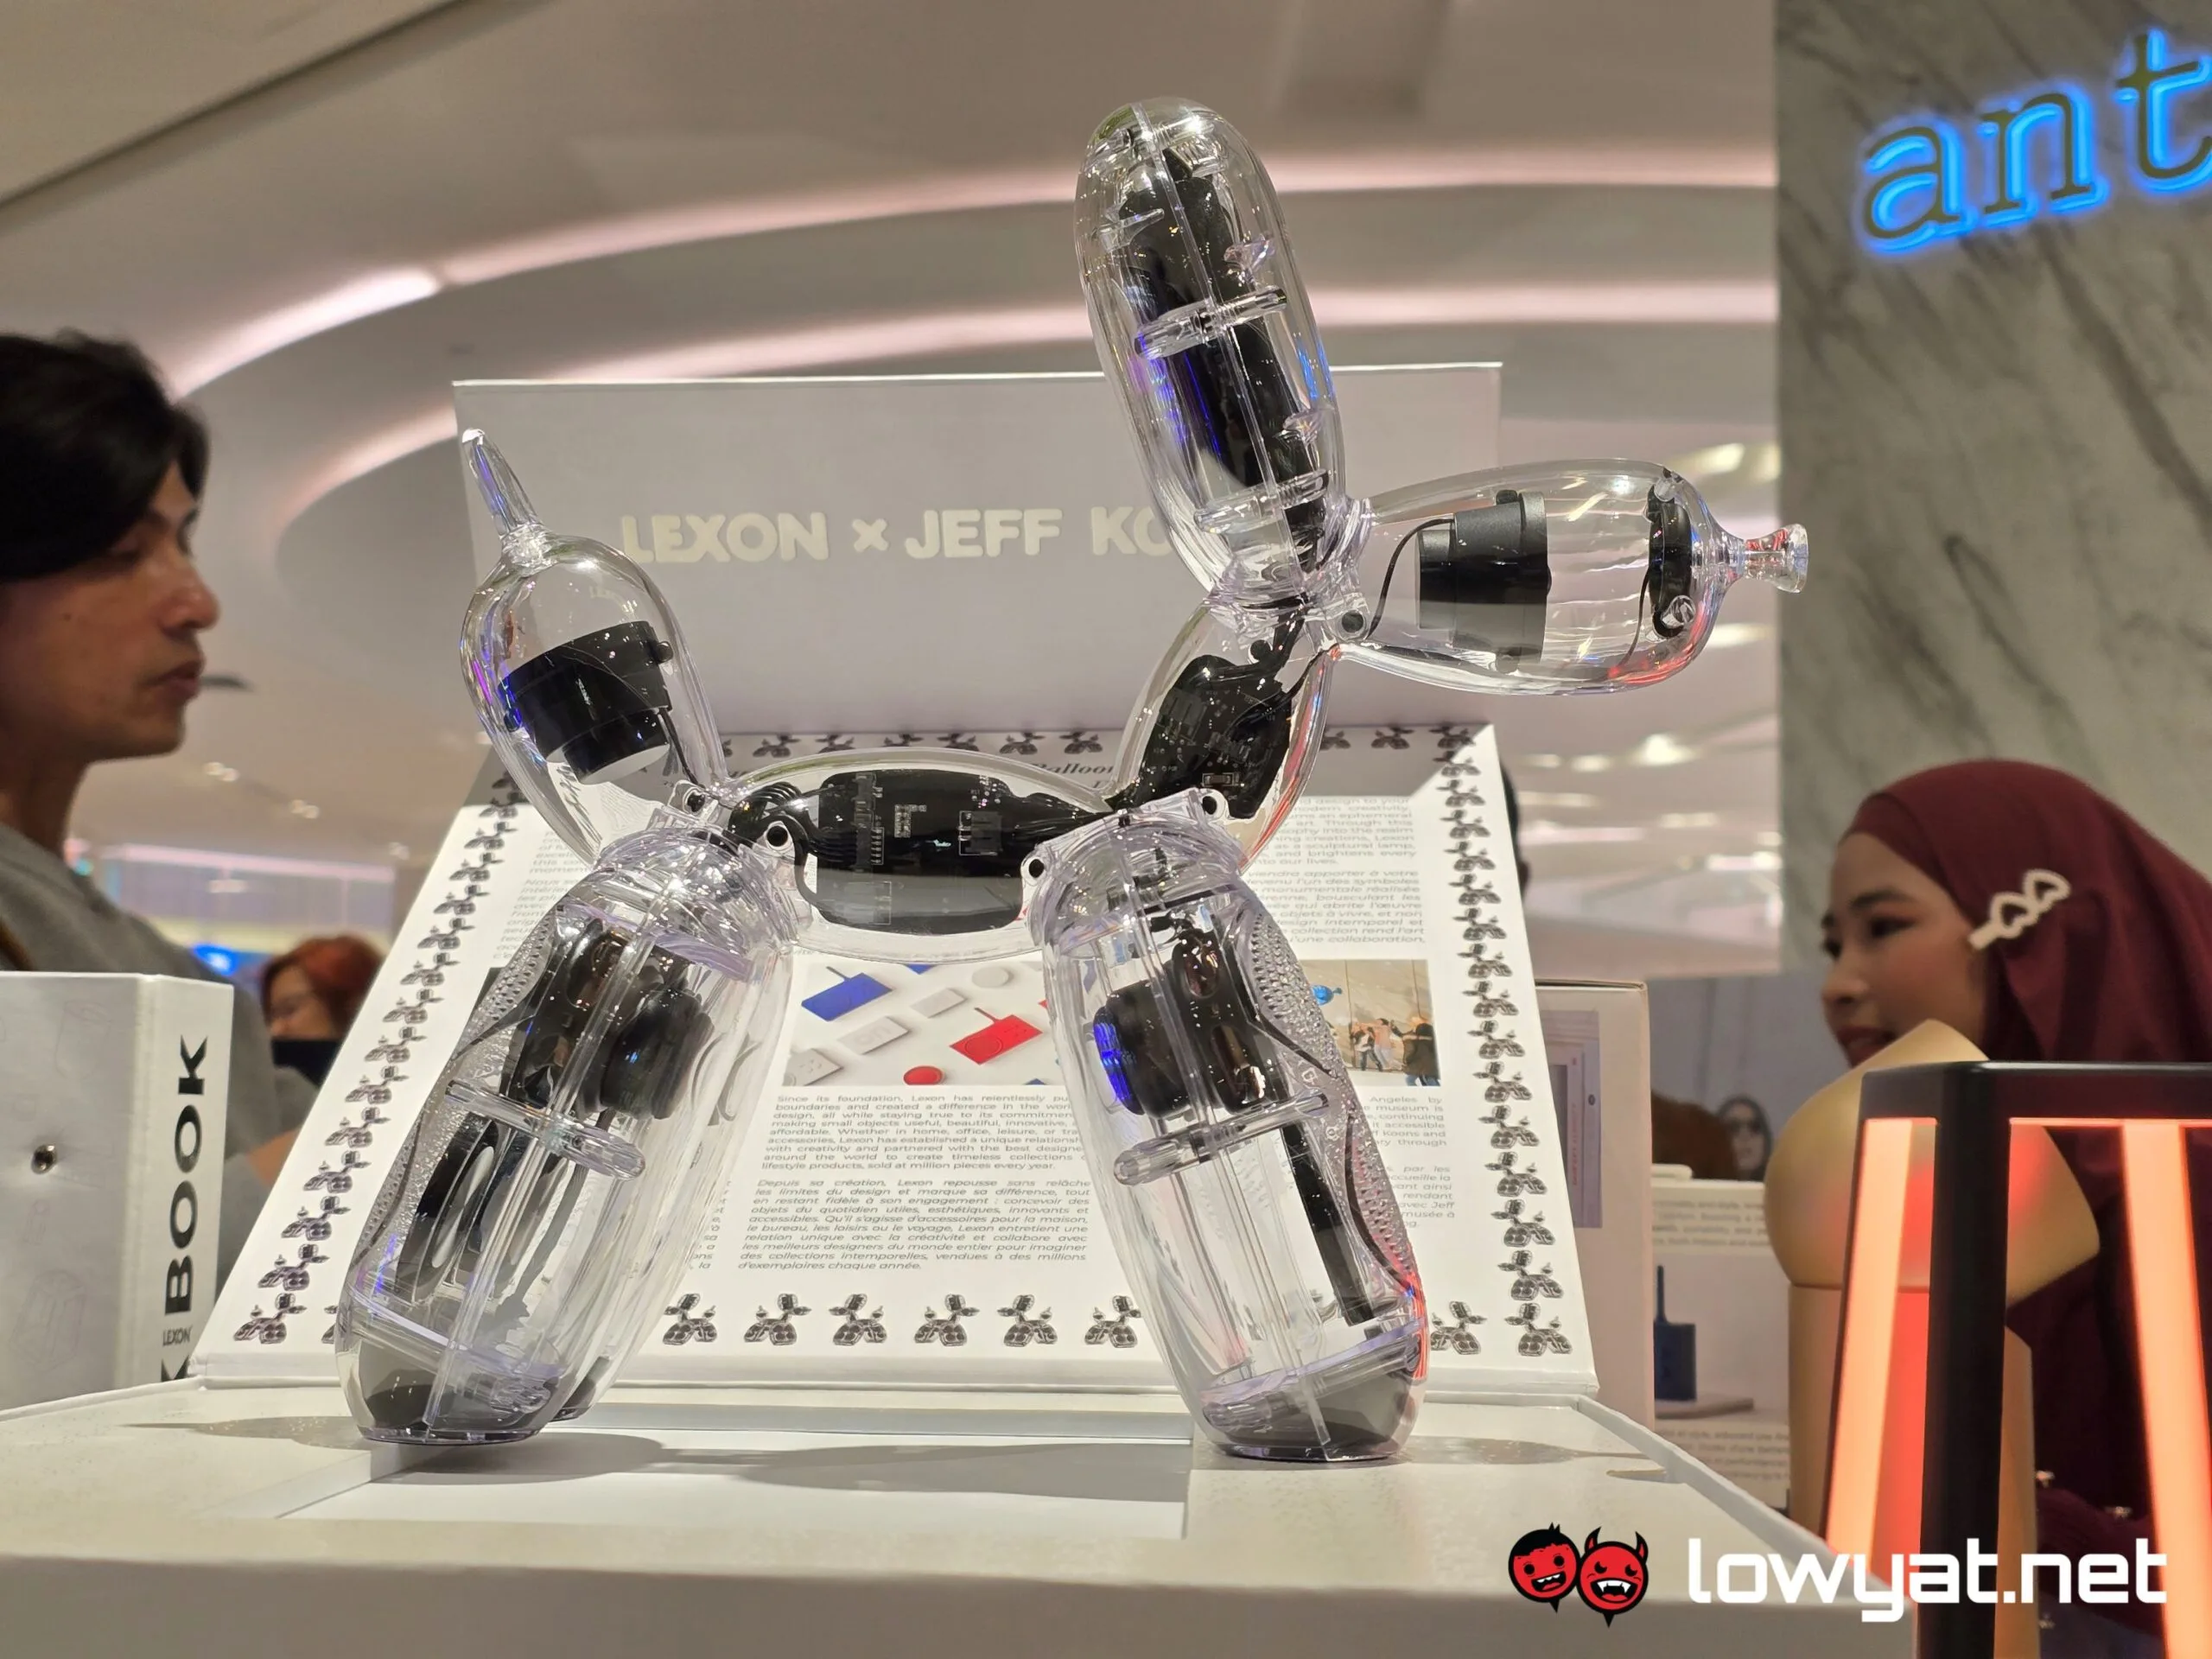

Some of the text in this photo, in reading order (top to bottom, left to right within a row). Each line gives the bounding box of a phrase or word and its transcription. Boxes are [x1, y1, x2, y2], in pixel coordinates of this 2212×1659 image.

[622, 512, 830, 563] LEXON
[904, 508, 1063, 559] JEFF
[1090, 505, 1173, 556] KO
[772, 1111, 814, 1120] design,
[880, 1111, 923, 1120] staying
[912, 1128, 950, 1136] home,
[956, 1128, 990, 1136] office,
[997, 1128, 1037, 1136] leisure,
[767, 1136, 836, 1145] accessories,
[980, 1136, 1023, 1145] unique
[797, 1144, 852, 1153] creativity
[883, 1144, 944, 1153] partnered
[762, 1161, 807, 1170] lifestyle
[809, 1161, 864, 1170] products,
[954, 1161, 990, 1170] pieces
[165, 1035, 208, 1315] BOOK
[757, 1179, 800, 1188] Depuis
[835, 1179, 887, 1188] création,
[850, 1187, 890, 1197] design
[995, 1187, 1058, 1197] différence,
[907, 1197, 988, 1206] engagement
[750, 1206, 788, 1215] objets
[819, 1206, 878, 1215] quotidien
[887, 1206, 919, 1215] utiles,
[928, 1206, 1001, 1215] esthétiques,
[824, 1215, 854, 1224] Qu'il
[855, 1215, 904, 1224] s'agisse
[1040, 1215, 1087, 1224] maison,
[760, 1224, 809, 1233] bureau,
[800, 1234, 845, 1243] unique
[823, 1243, 883, 1252] designers
[1030, 1243, 1087, 1252] imaginer
[840, 1252, 928, 1262] intemporelles,
[738, 1262, 826, 1270] d'exemplaires
[828, 1262, 876, 1270] chaque
